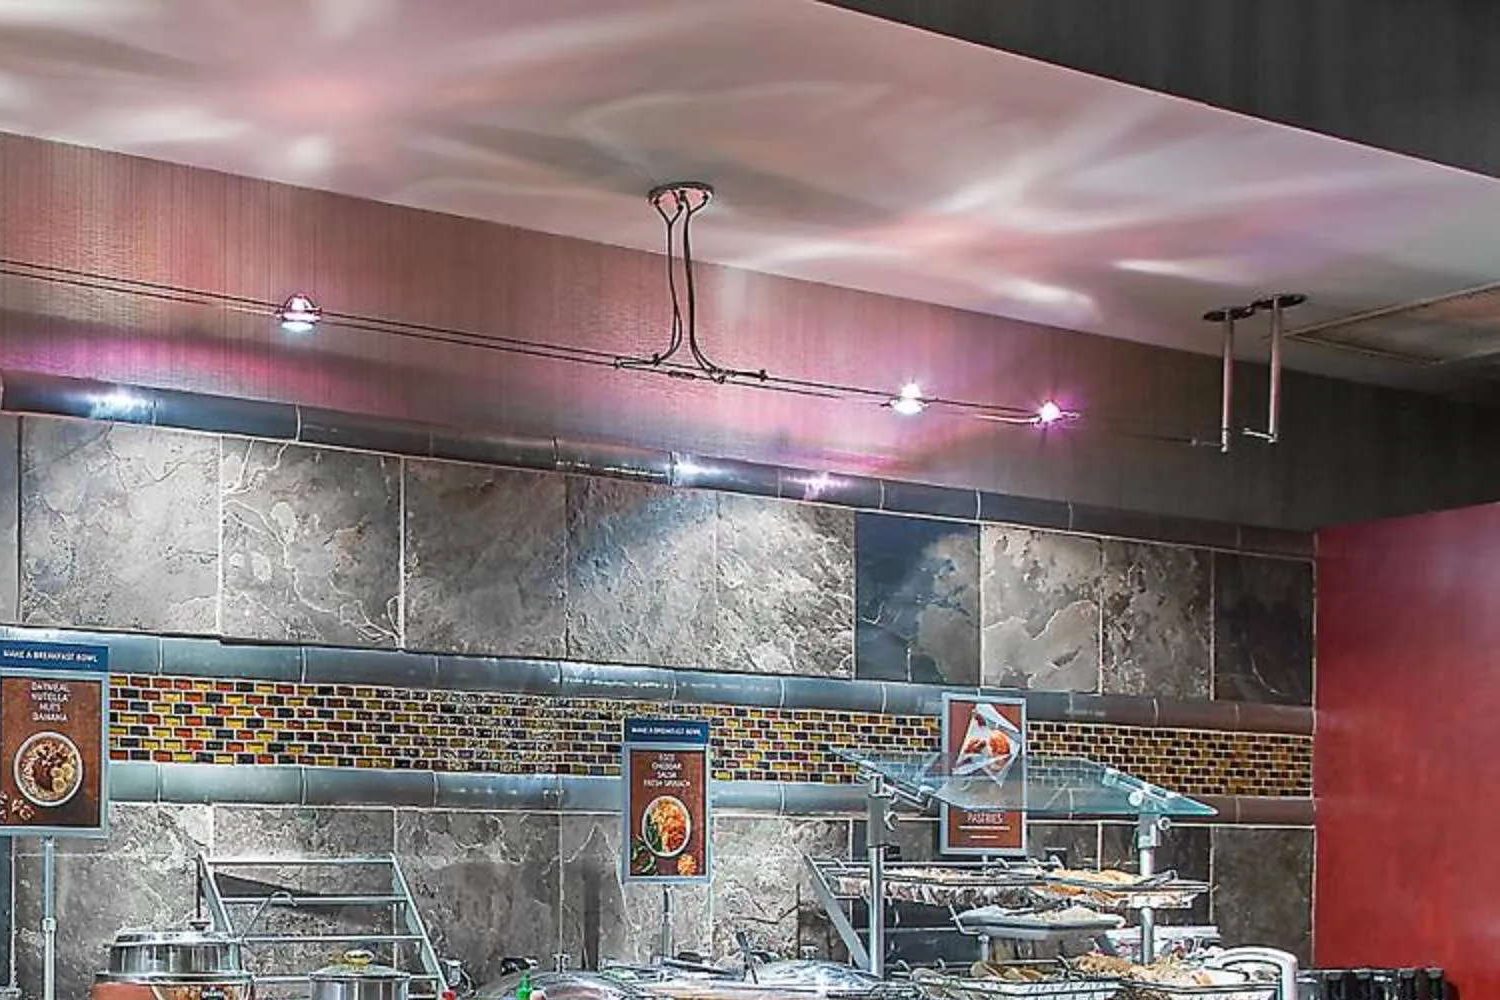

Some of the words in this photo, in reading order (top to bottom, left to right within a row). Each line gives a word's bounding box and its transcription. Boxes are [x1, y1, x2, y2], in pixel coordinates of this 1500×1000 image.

[3, 649, 25, 658] MAKE
[33, 651, 75, 661] BREAKFAST
[75, 653, 98, 662] BOWL
